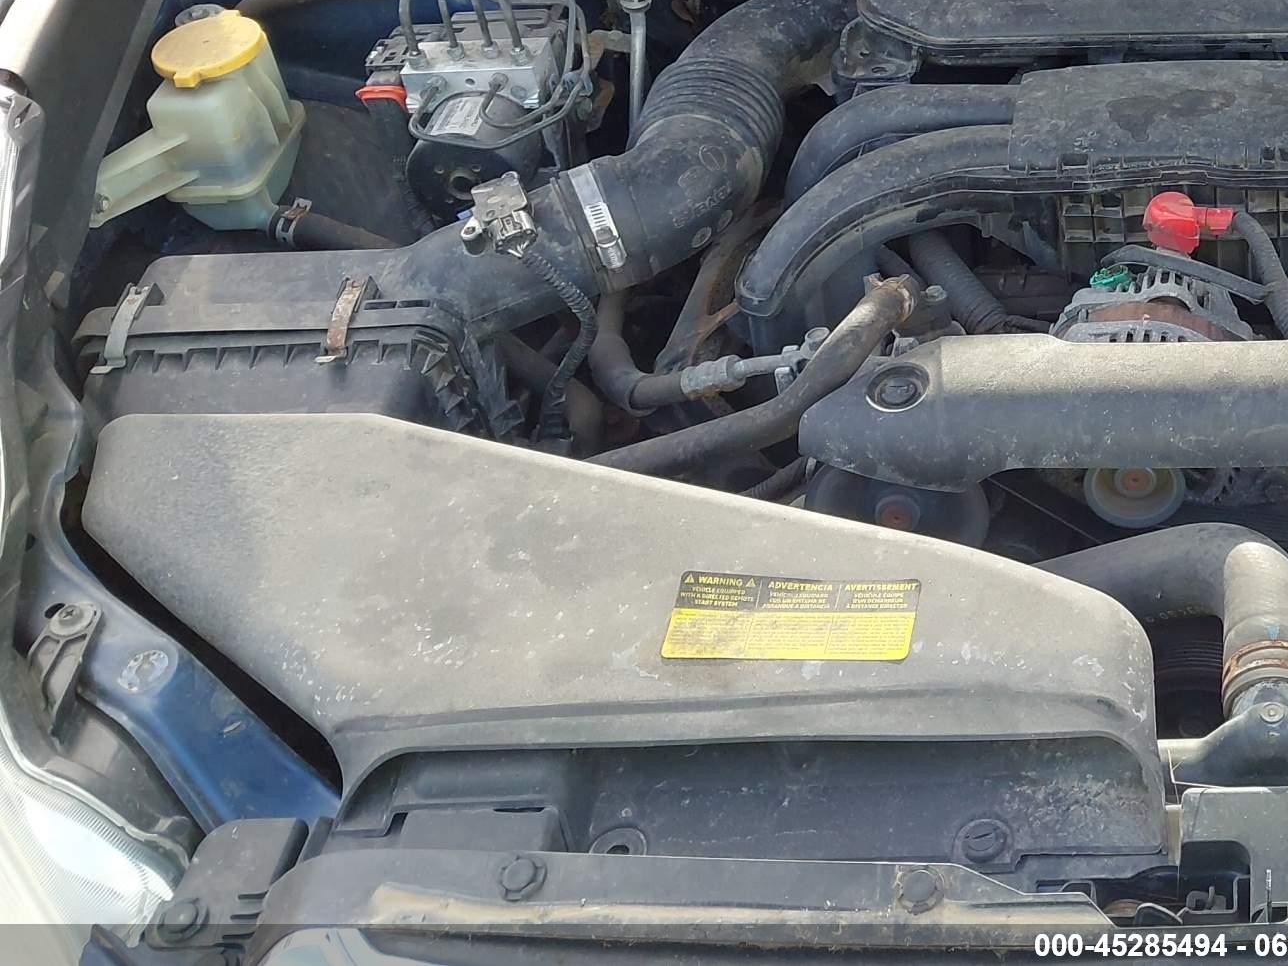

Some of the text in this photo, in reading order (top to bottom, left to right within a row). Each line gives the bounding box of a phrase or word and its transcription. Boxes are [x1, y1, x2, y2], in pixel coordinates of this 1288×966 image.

[698, 576, 743, 587] WARNING
[768, 581, 833, 591] ADVERTENCIA
[844, 583, 919, 591] AVERTISSEMENT
